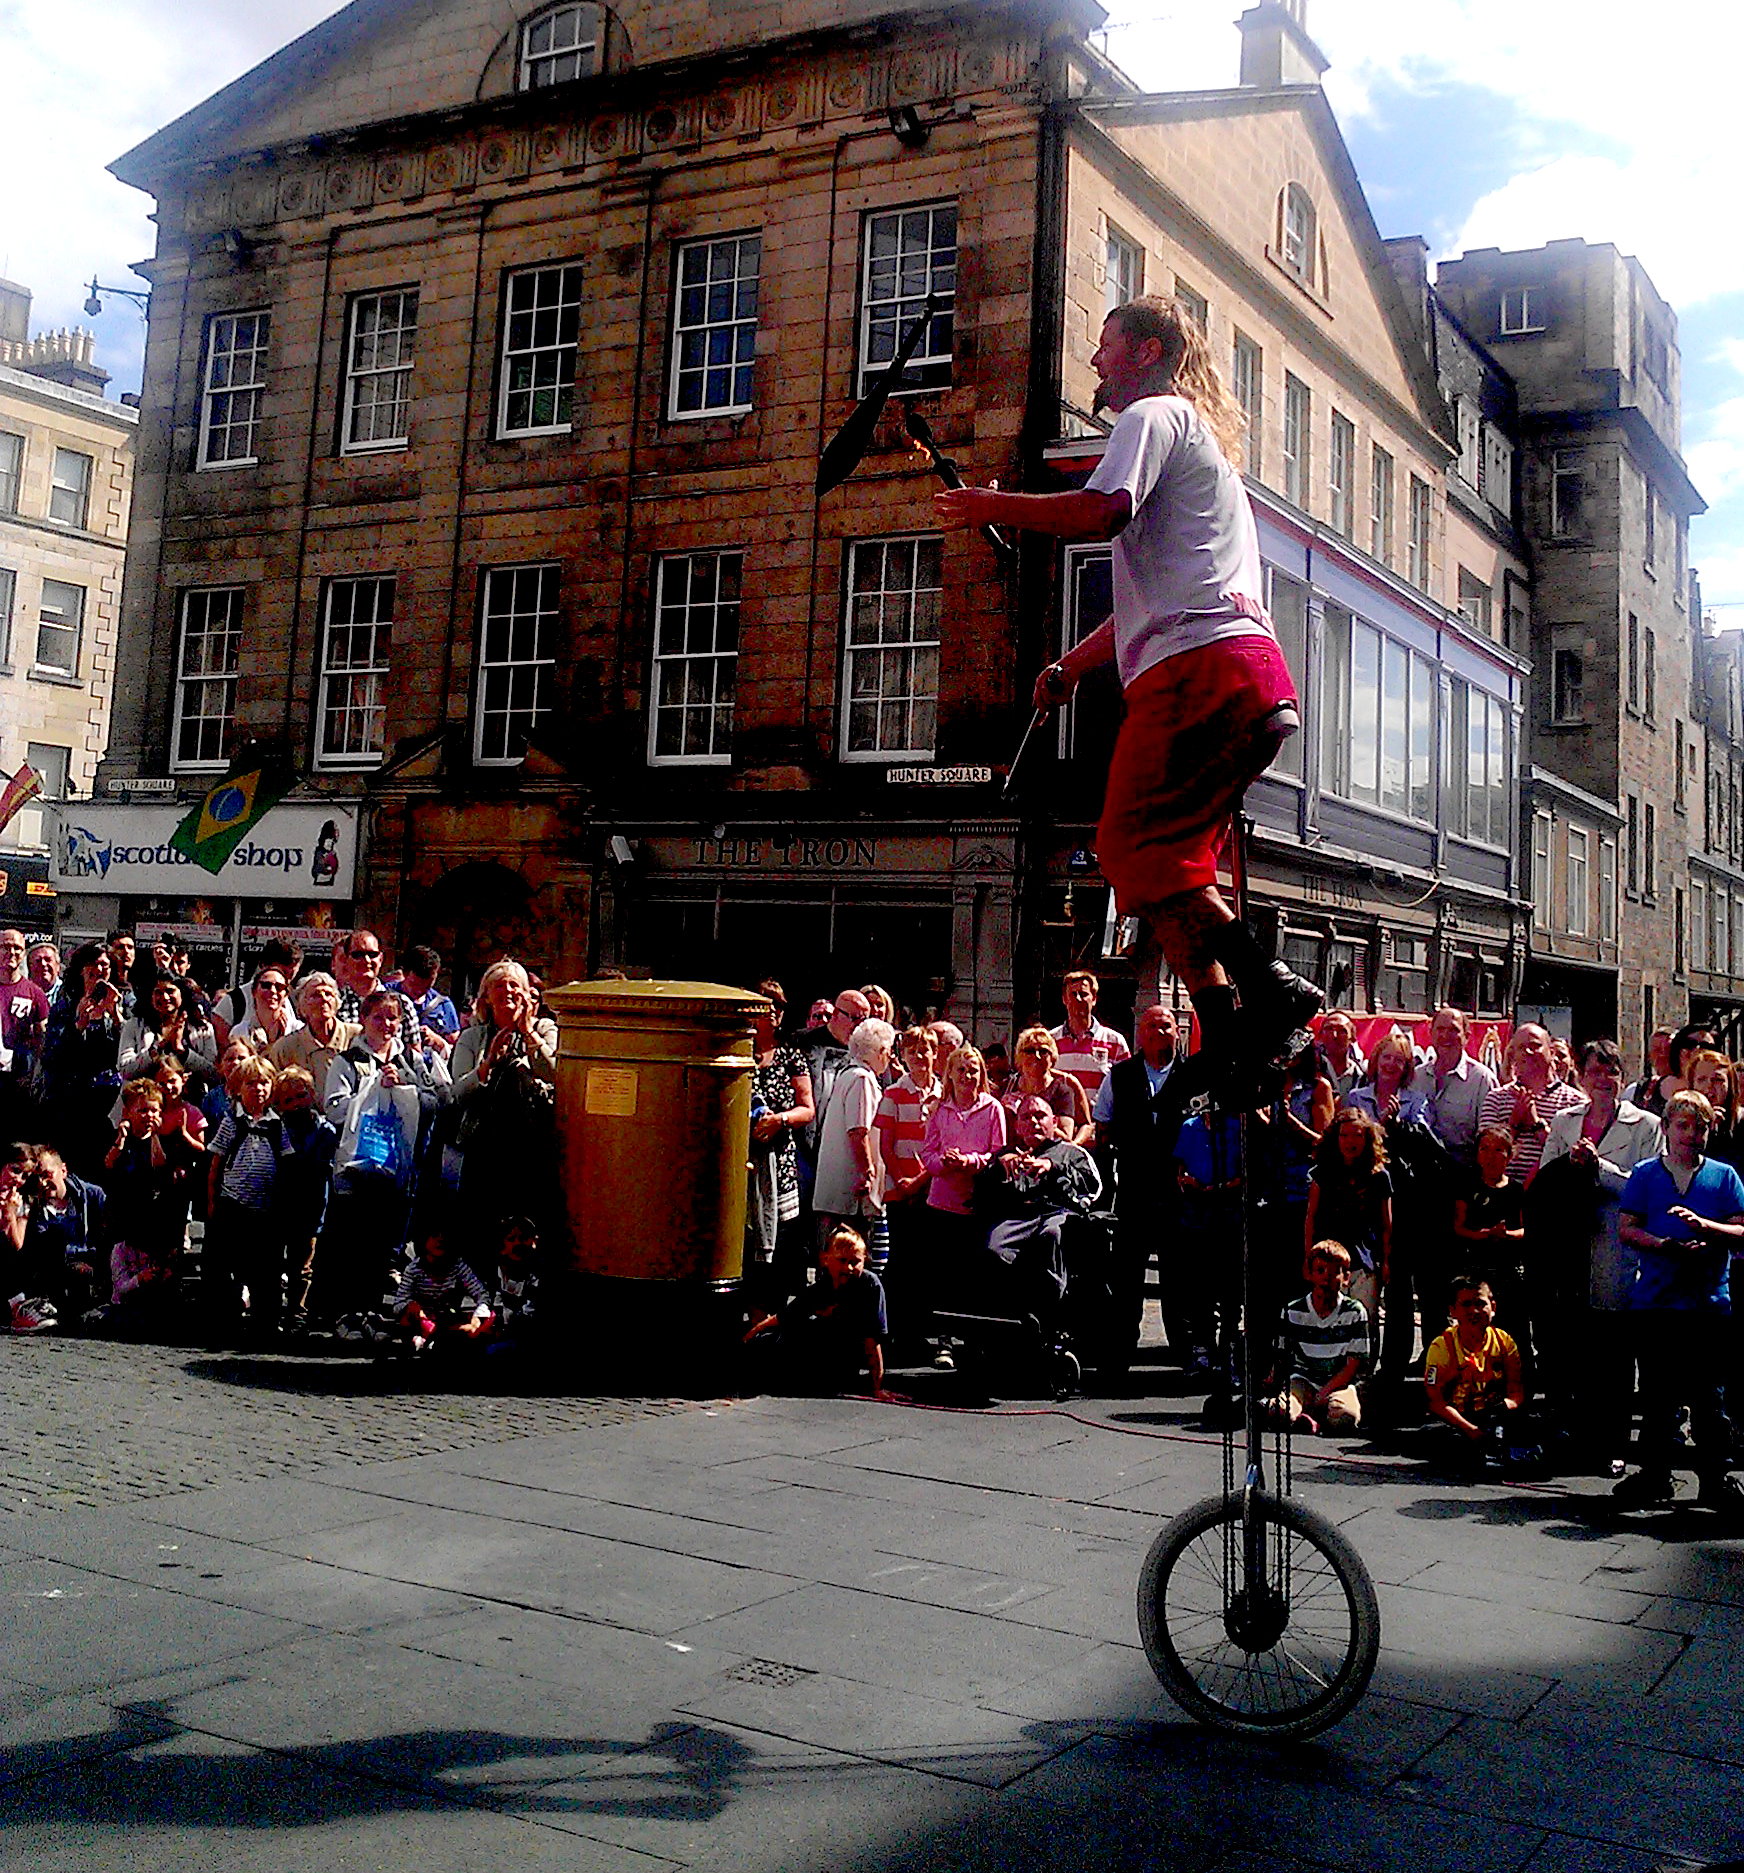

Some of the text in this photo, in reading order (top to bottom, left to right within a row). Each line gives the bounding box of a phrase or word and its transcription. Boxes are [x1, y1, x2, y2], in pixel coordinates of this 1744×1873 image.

[890, 766, 989, 783] HUNTER SQUARE
[112, 842, 302, 872] scotla shop
[693, 837, 882, 867] THE TRON
[1302, 873, 1328, 902] THE
